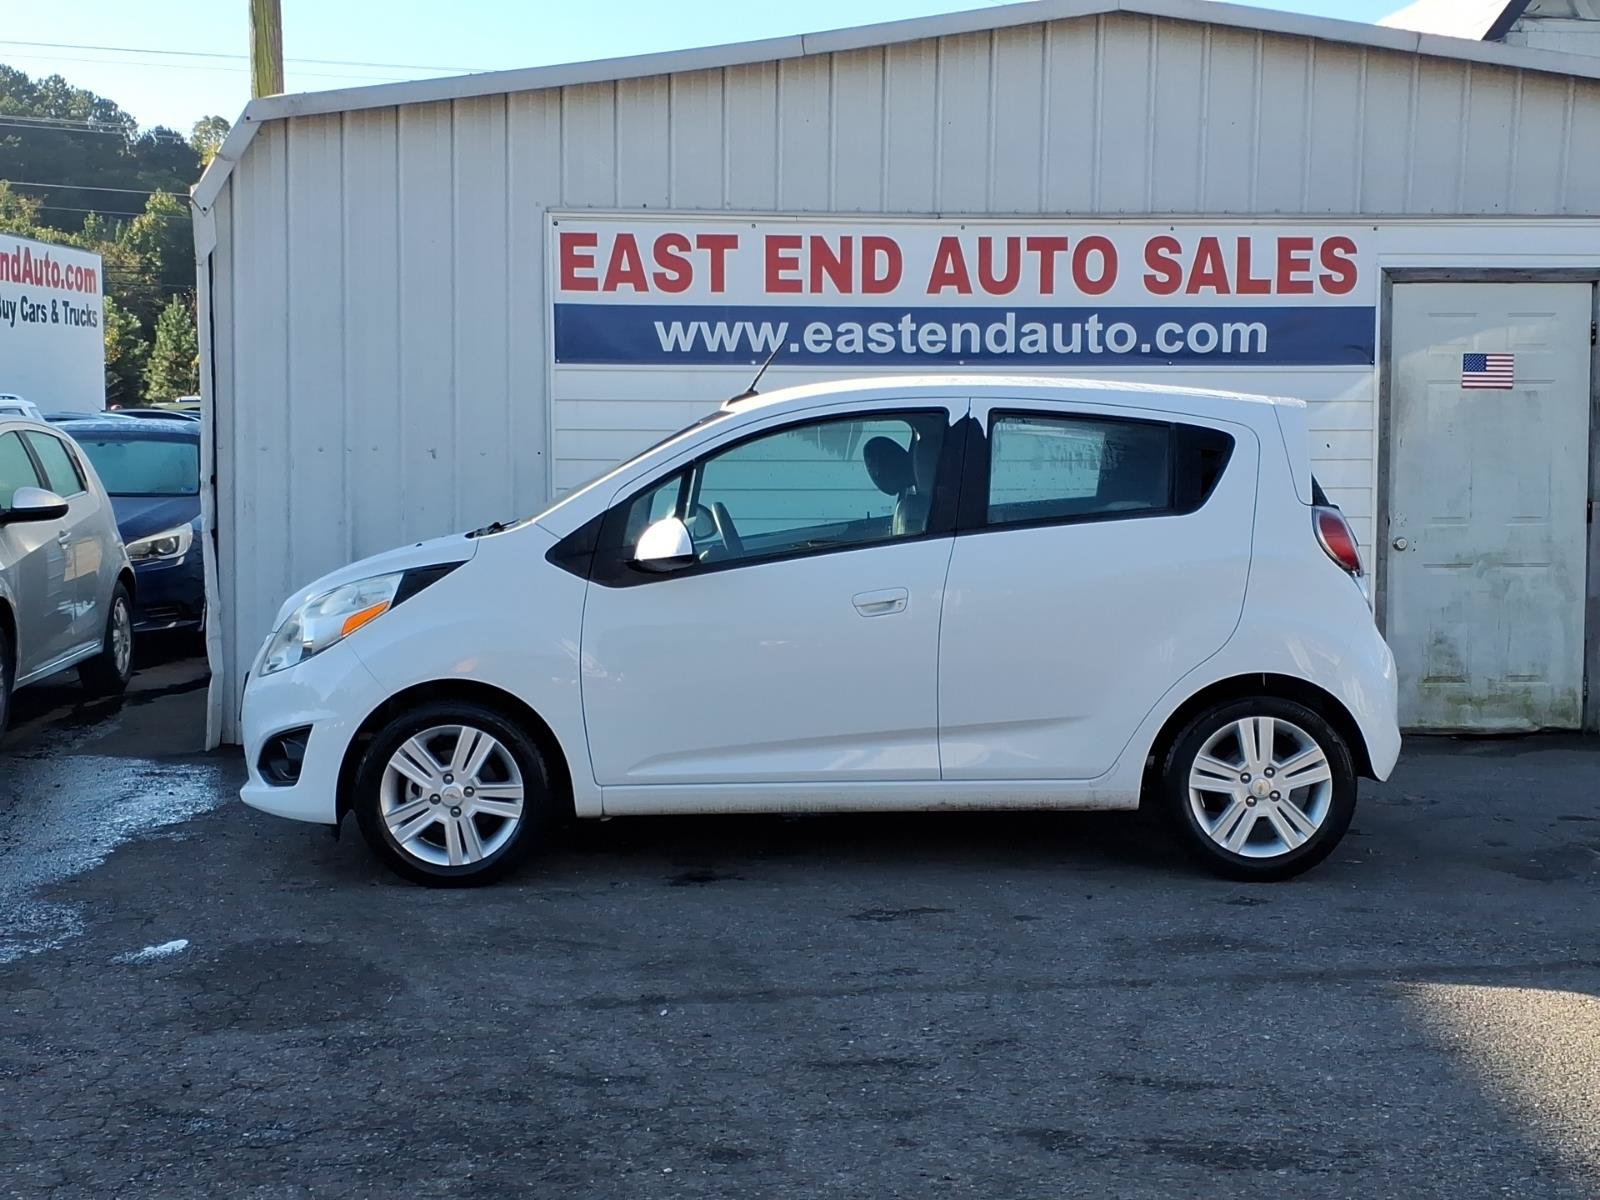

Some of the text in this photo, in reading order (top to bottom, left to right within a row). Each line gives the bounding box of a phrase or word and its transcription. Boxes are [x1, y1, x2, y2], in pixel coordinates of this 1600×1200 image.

[560, 232, 1359, 296] EAST END AUTO SALES
[0, 295, 98, 328] uy Cars & Trucks
[654, 312, 1268, 354] www.eastendauto.com
